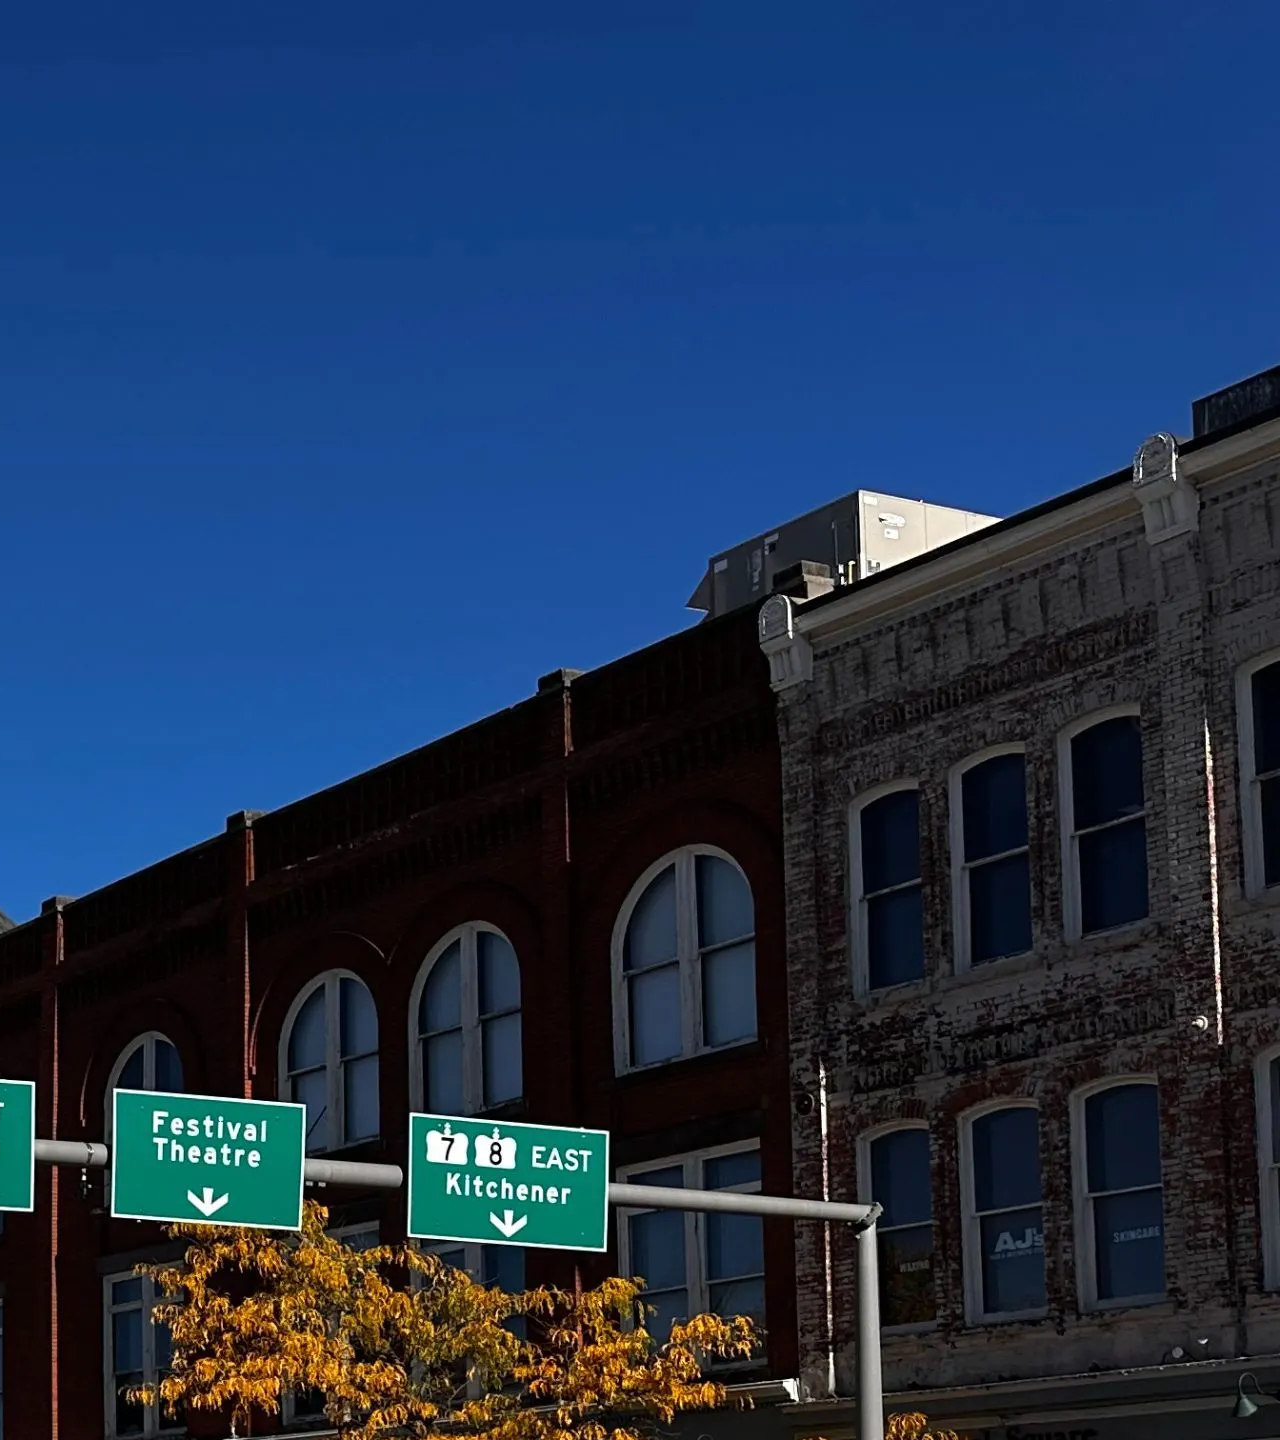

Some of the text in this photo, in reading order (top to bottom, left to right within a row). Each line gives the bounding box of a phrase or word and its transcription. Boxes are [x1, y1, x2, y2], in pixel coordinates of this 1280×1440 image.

[152, 1110, 267, 1142] Festival
[153, 1137, 261, 1168] Theatre
[441, 1137, 592, 1172] 7 8 EAST
[446, 1172, 571, 1204] Kitchener
[994, 1227, 1044, 1253] AJ's
[1113, 1225, 1161, 1243] SKINCARE
